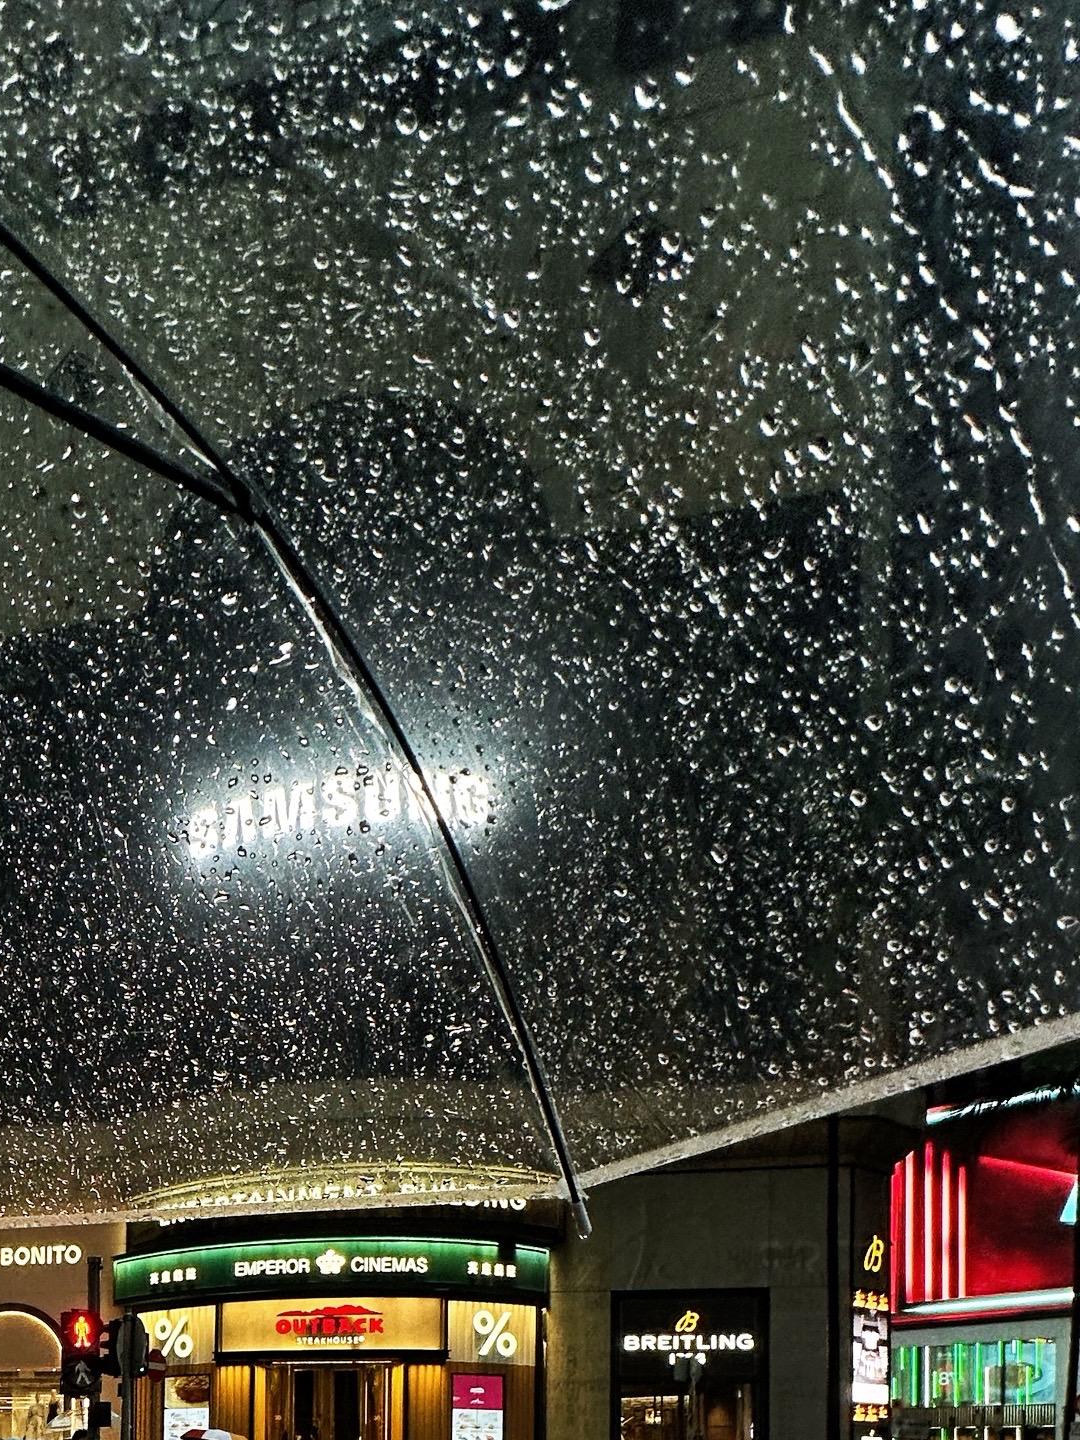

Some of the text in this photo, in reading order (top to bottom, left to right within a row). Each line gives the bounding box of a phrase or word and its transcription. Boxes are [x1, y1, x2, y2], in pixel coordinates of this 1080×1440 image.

[187, 762, 489, 858] SAMSUNG
[0, 1244, 82, 1266] BONITO
[234, 1255, 429, 1277] EMPEROR CINEMAS
[275, 1317, 384, 1335] OUTBACK
[623, 1333, 755, 1351] BREITLING
